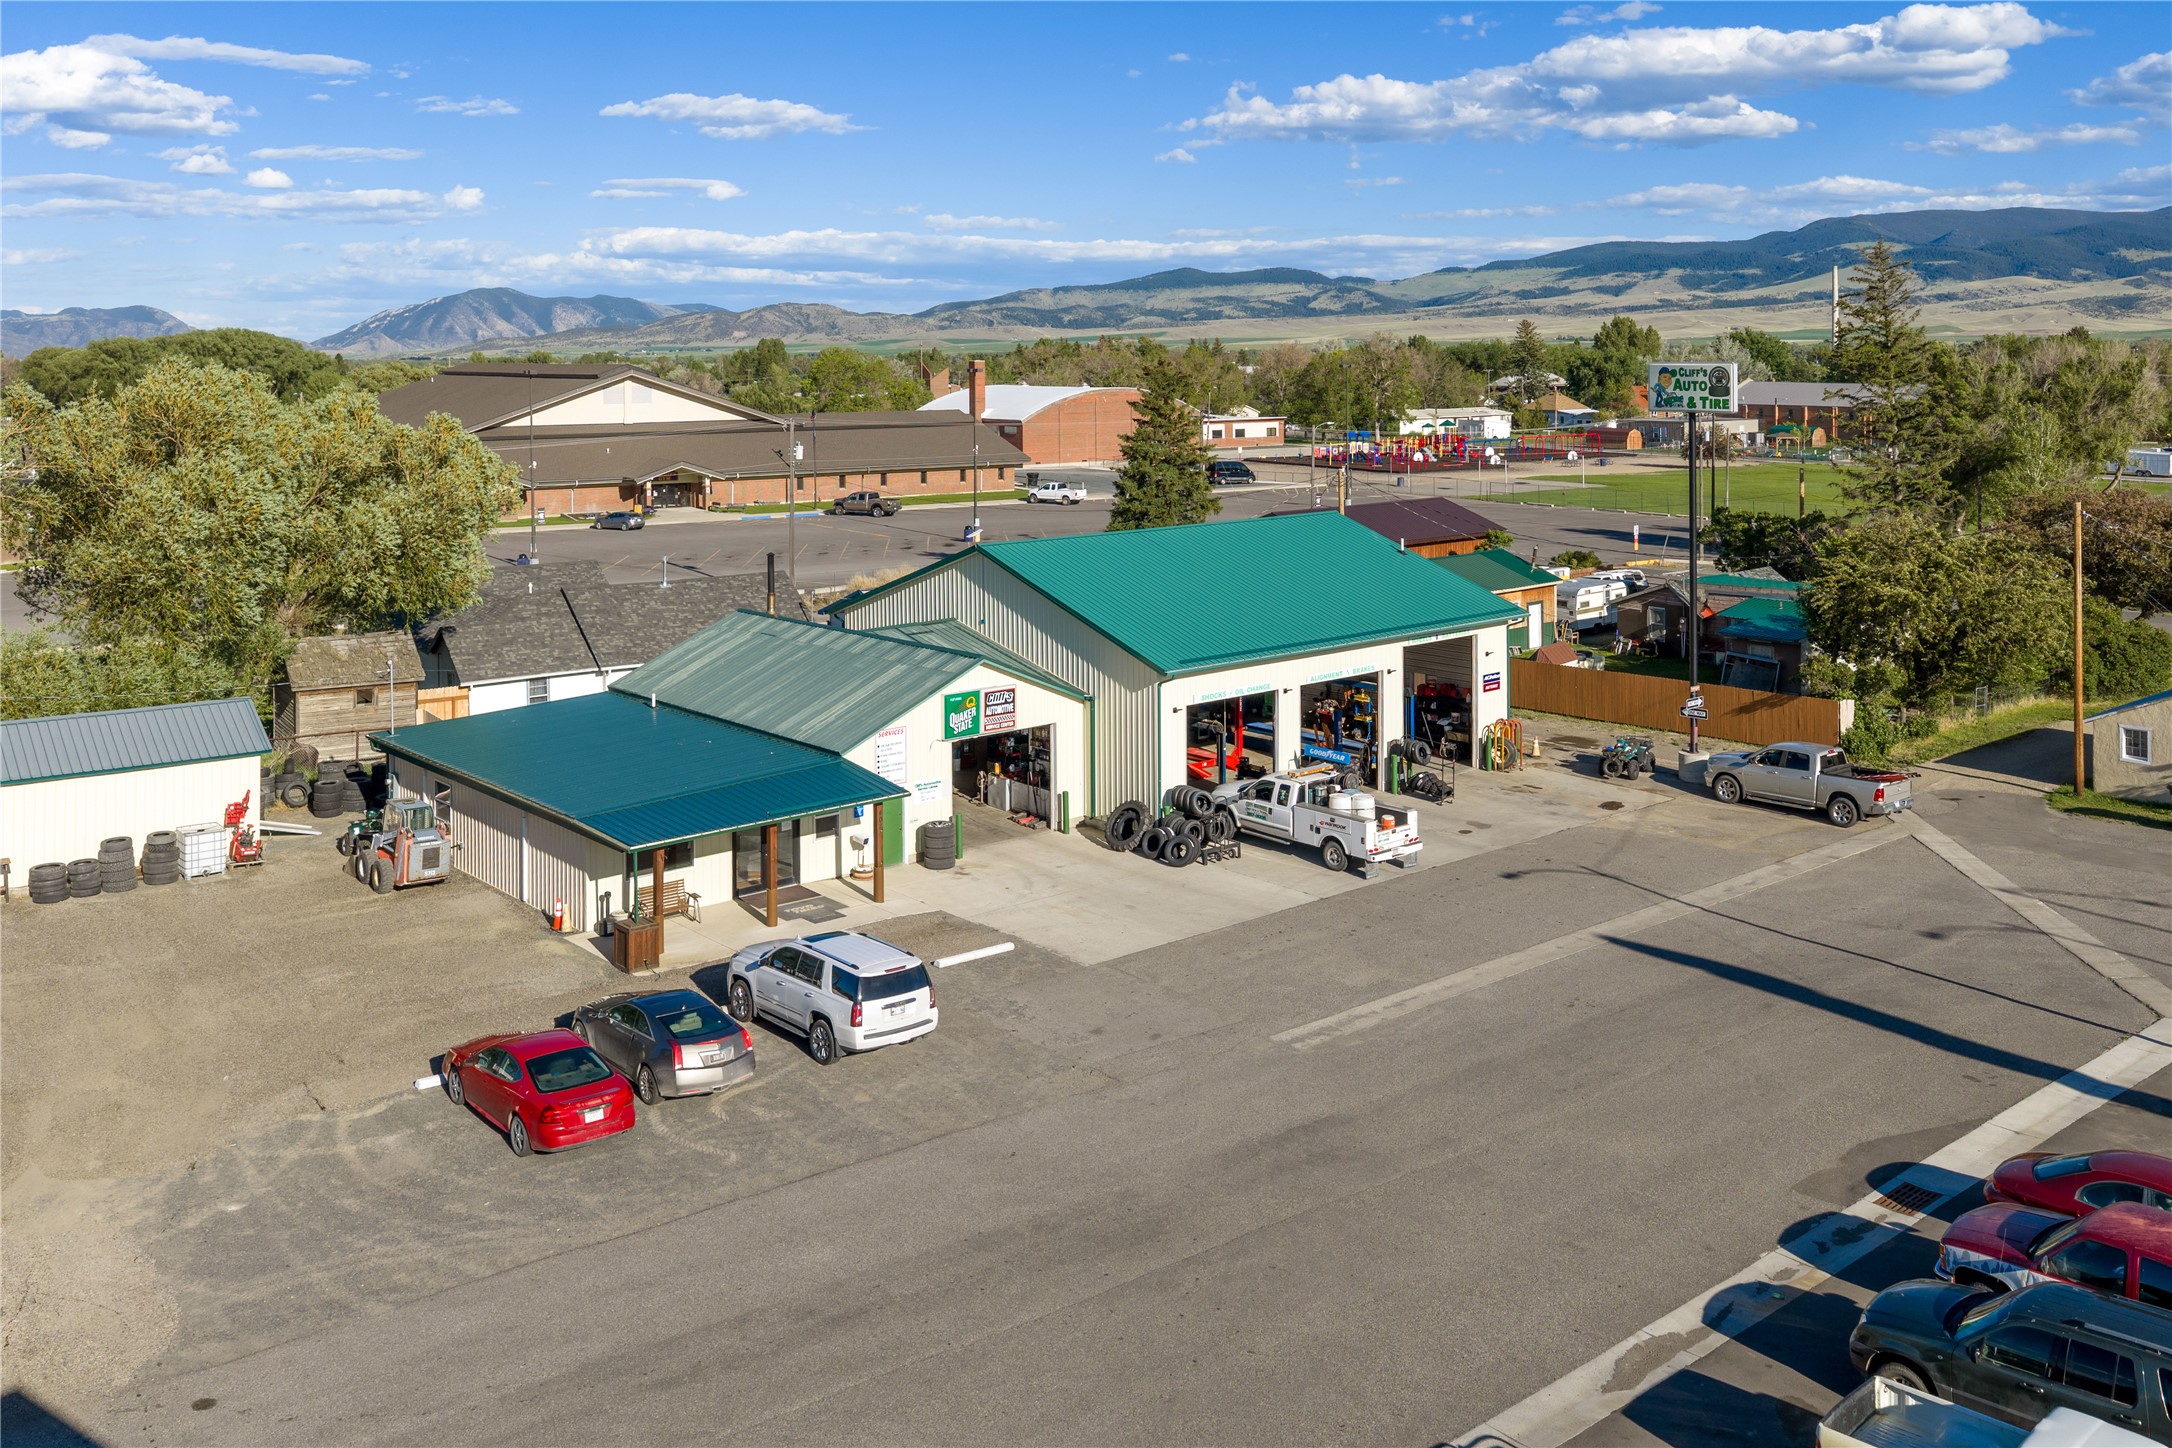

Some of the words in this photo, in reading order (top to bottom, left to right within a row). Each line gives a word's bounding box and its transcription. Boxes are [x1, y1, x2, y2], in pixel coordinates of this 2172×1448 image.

[1673, 378, 1708, 391] AUTO
[1686, 396, 1697, 409] &
[1699, 396, 1730, 410] TIRE
[1310, 671, 1344, 682] ALIGNMENT
[1352, 665, 1376, 674] BRAKES
[1201, 691, 1227, 701] SHOCKS
[1246, 683, 1271, 693] CHANGE
[985, 703, 1015, 716] AUTOMOTIVE
[949, 707, 976, 727] QUAKER
[878, 728, 904, 738] SERVICES
[953, 718, 973, 734] STATE
[1309, 748, 1346, 761] GOODYEAR
